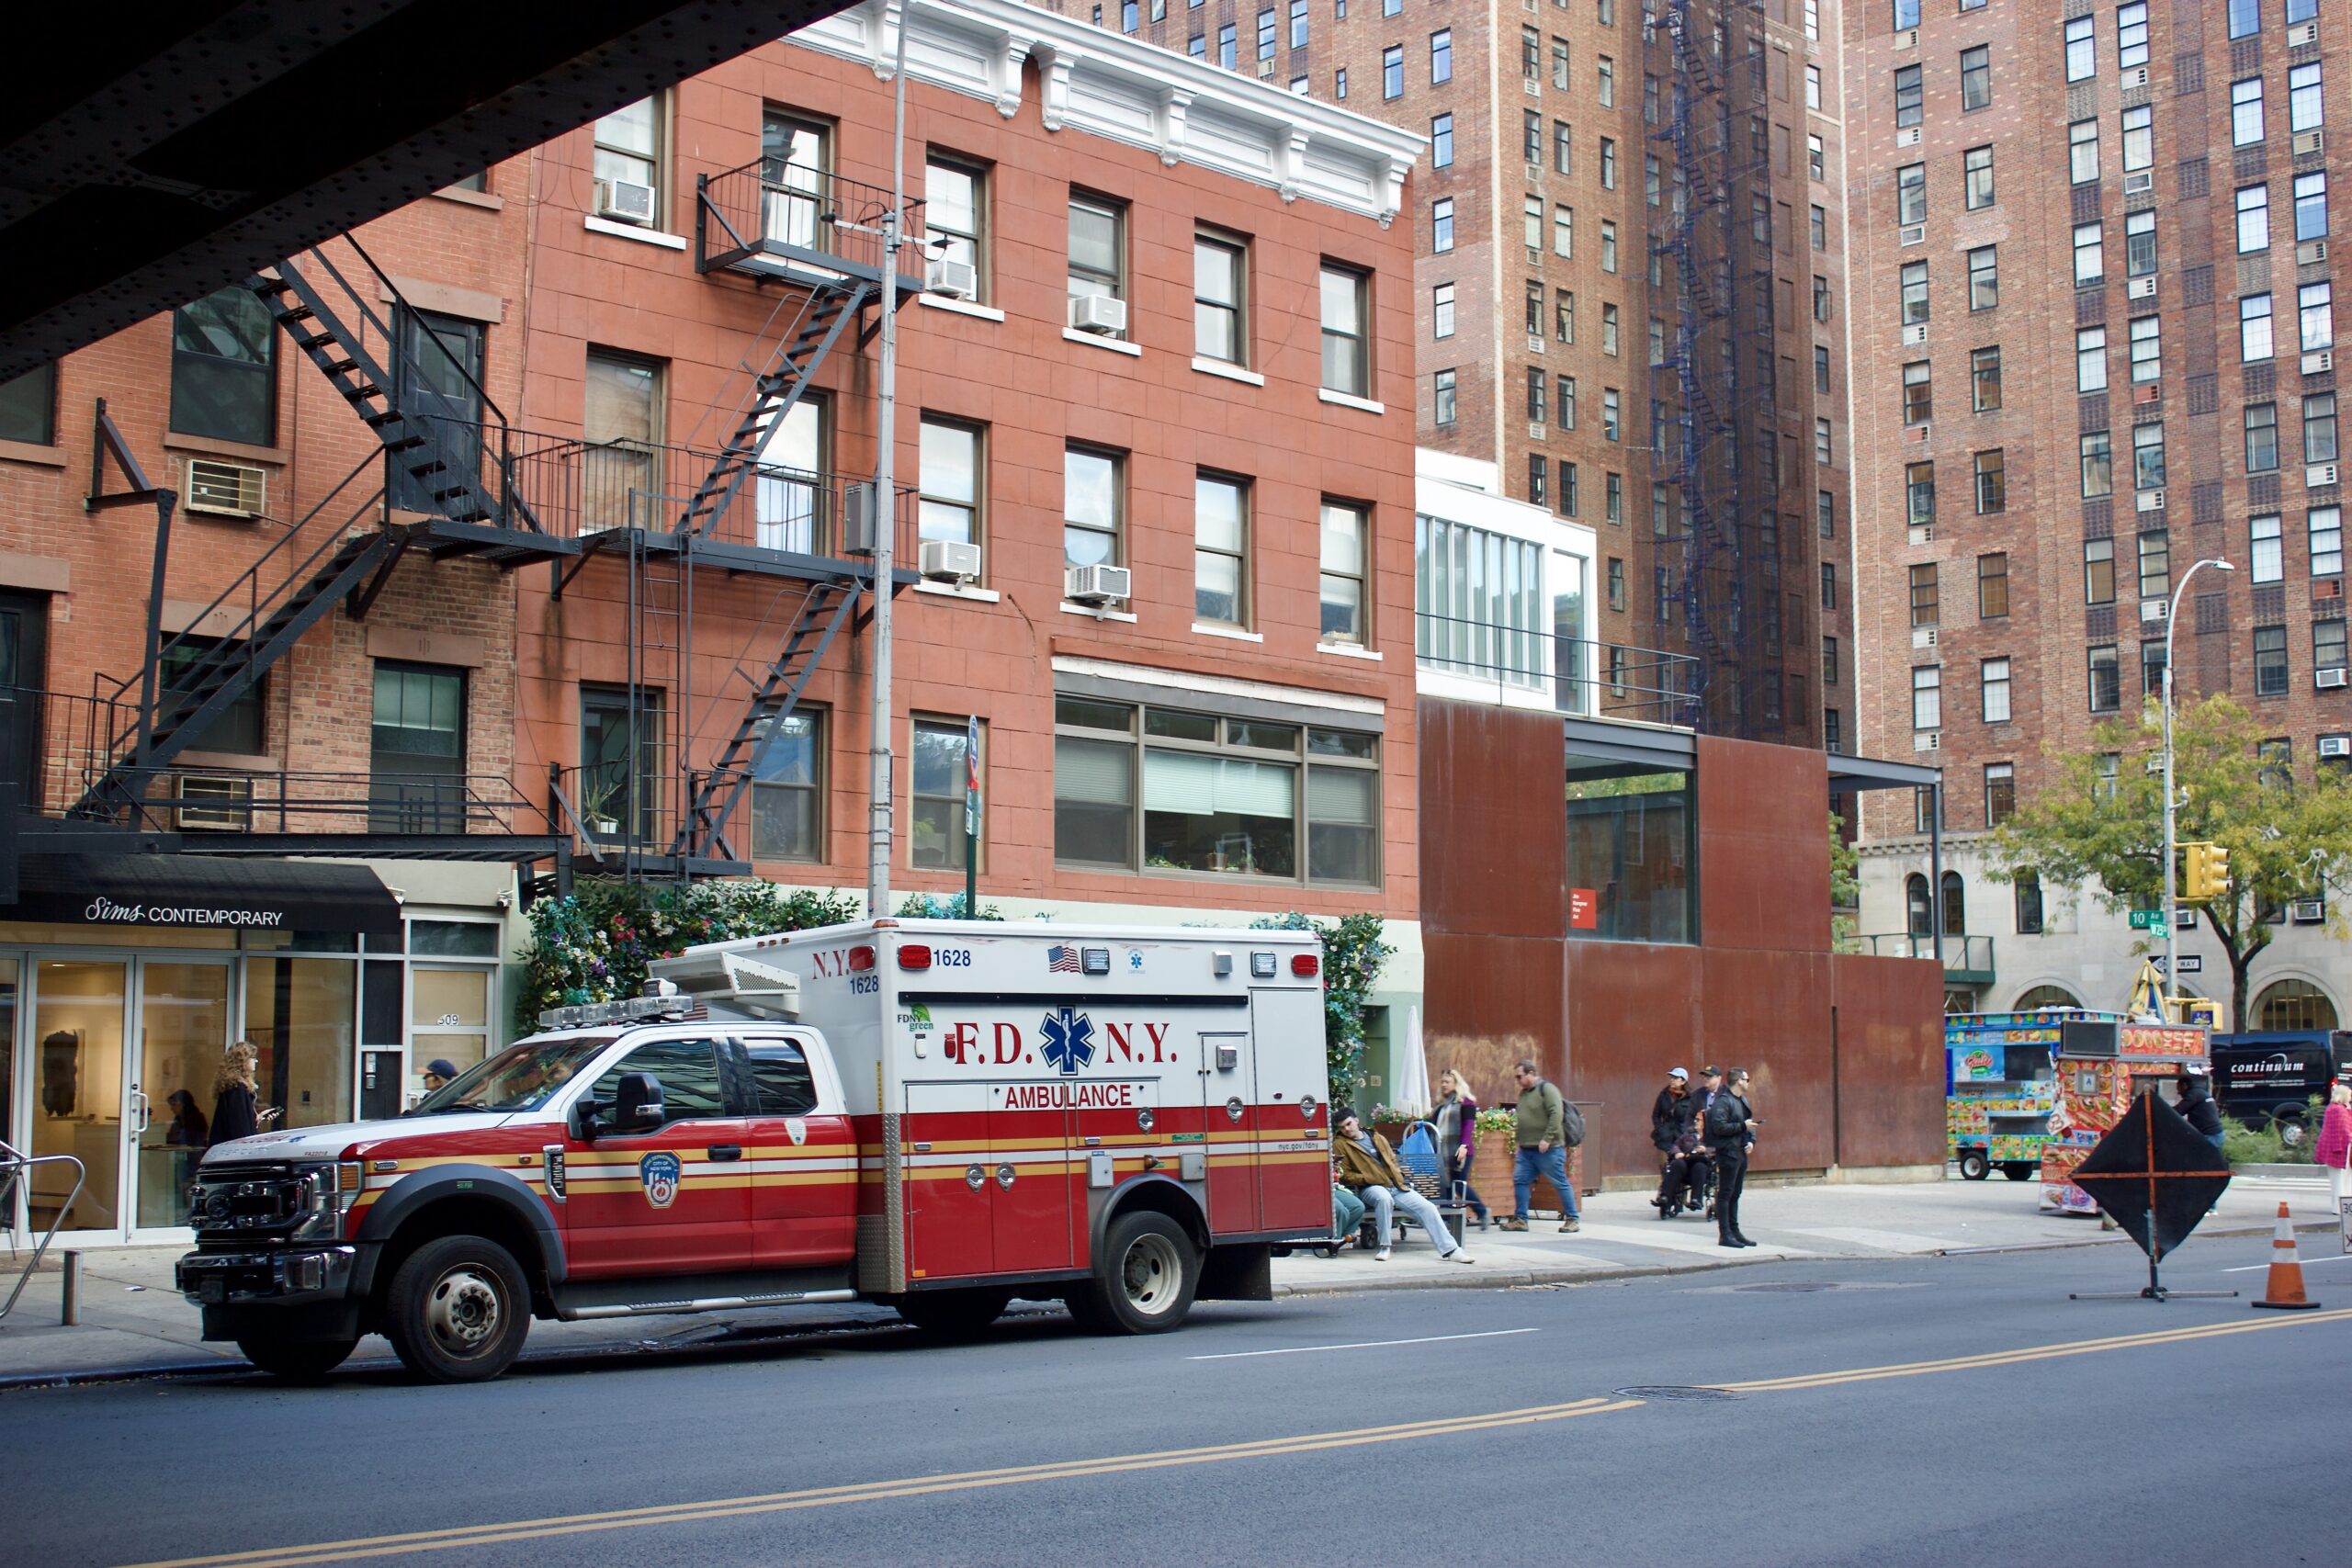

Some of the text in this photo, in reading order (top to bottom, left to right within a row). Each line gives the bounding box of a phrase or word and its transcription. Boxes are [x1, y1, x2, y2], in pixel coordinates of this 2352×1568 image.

[85, 896, 283, 926] Sims CONTEMPORARY
[2133, 913, 2145, 923] 10
[812, 949, 850, 980] N.Y.
[933, 949, 971, 967] 1628
[850, 975, 879, 995] 1628
[897, 1014, 922, 1023] FDNY
[909, 1021, 934, 1032] green
[954, 1021, 1178, 1065] F.D. N.Y.
[2231, 1060, 2304, 1073] continuum
[2086, 1077, 2092, 1086] A
[1005, 1083, 1132, 1110] AMBULANCE
